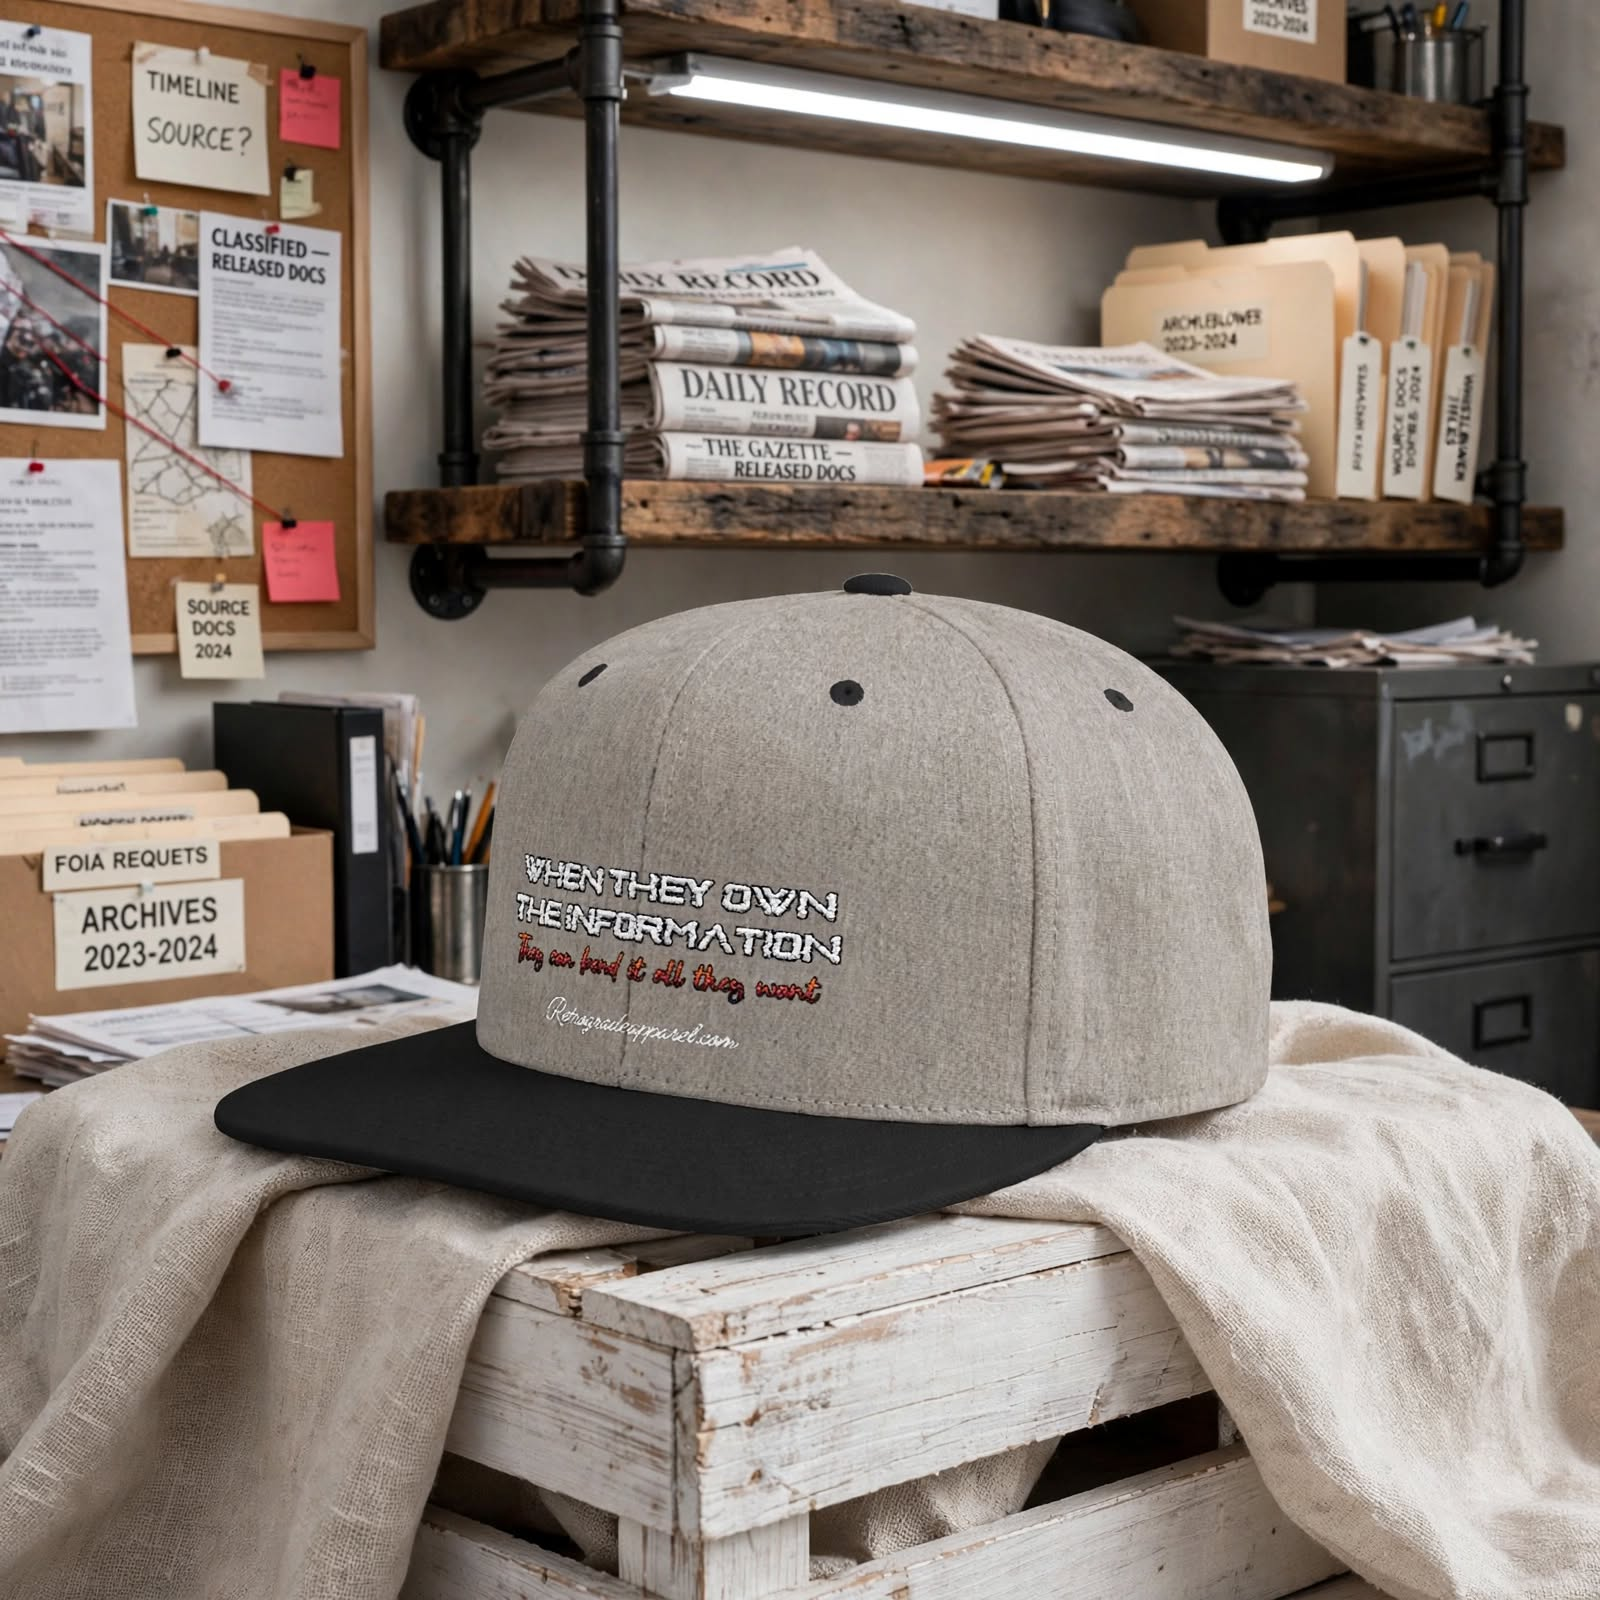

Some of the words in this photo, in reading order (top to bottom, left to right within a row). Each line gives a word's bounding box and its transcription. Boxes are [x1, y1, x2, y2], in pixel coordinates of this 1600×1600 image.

[147, 70, 239, 104] TIMELINE
[147, 116, 252, 156] SOURCE?
[212, 227, 307, 258] CLASSIFIED
[212, 252, 285, 279] RELEASED
[289, 263, 326, 285] DOCS
[553, 265, 666, 287] DILY
[677, 270, 820, 289] RECORD
[679, 367, 768, 404] DAILY
[778, 376, 897, 412] RECORD
[703, 437, 744, 457] THE
[748, 440, 831, 461] GAZETTE
[734, 460, 812, 480] RELEASED
[816, 463, 856, 481] DOCS
[187, 598, 250, 616] SOURCE
[192, 620, 236, 636] DOCS
[195, 643, 232, 659] 2024
[55, 854, 105, 874] FOIA
[113, 846, 208, 870] REQUETS
[524, 853, 605, 896] WHEN
[608, 867, 715, 909] THEY
[721, 882, 839, 923] OWN
[81, 897, 217, 935] ARCHIVES
[516, 891, 563, 931] THE
[564, 902, 843, 965] INFORMATION
[84, 933, 218, 972] 2023-2024
[517, 932, 544, 972] They
[626, 956, 647, 983] it
[652, 959, 687, 987] all
[693, 963, 745, 1004] they
[755, 975, 822, 1004] want
[545, 996, 740, 1050] Retrogradeapparel.com
